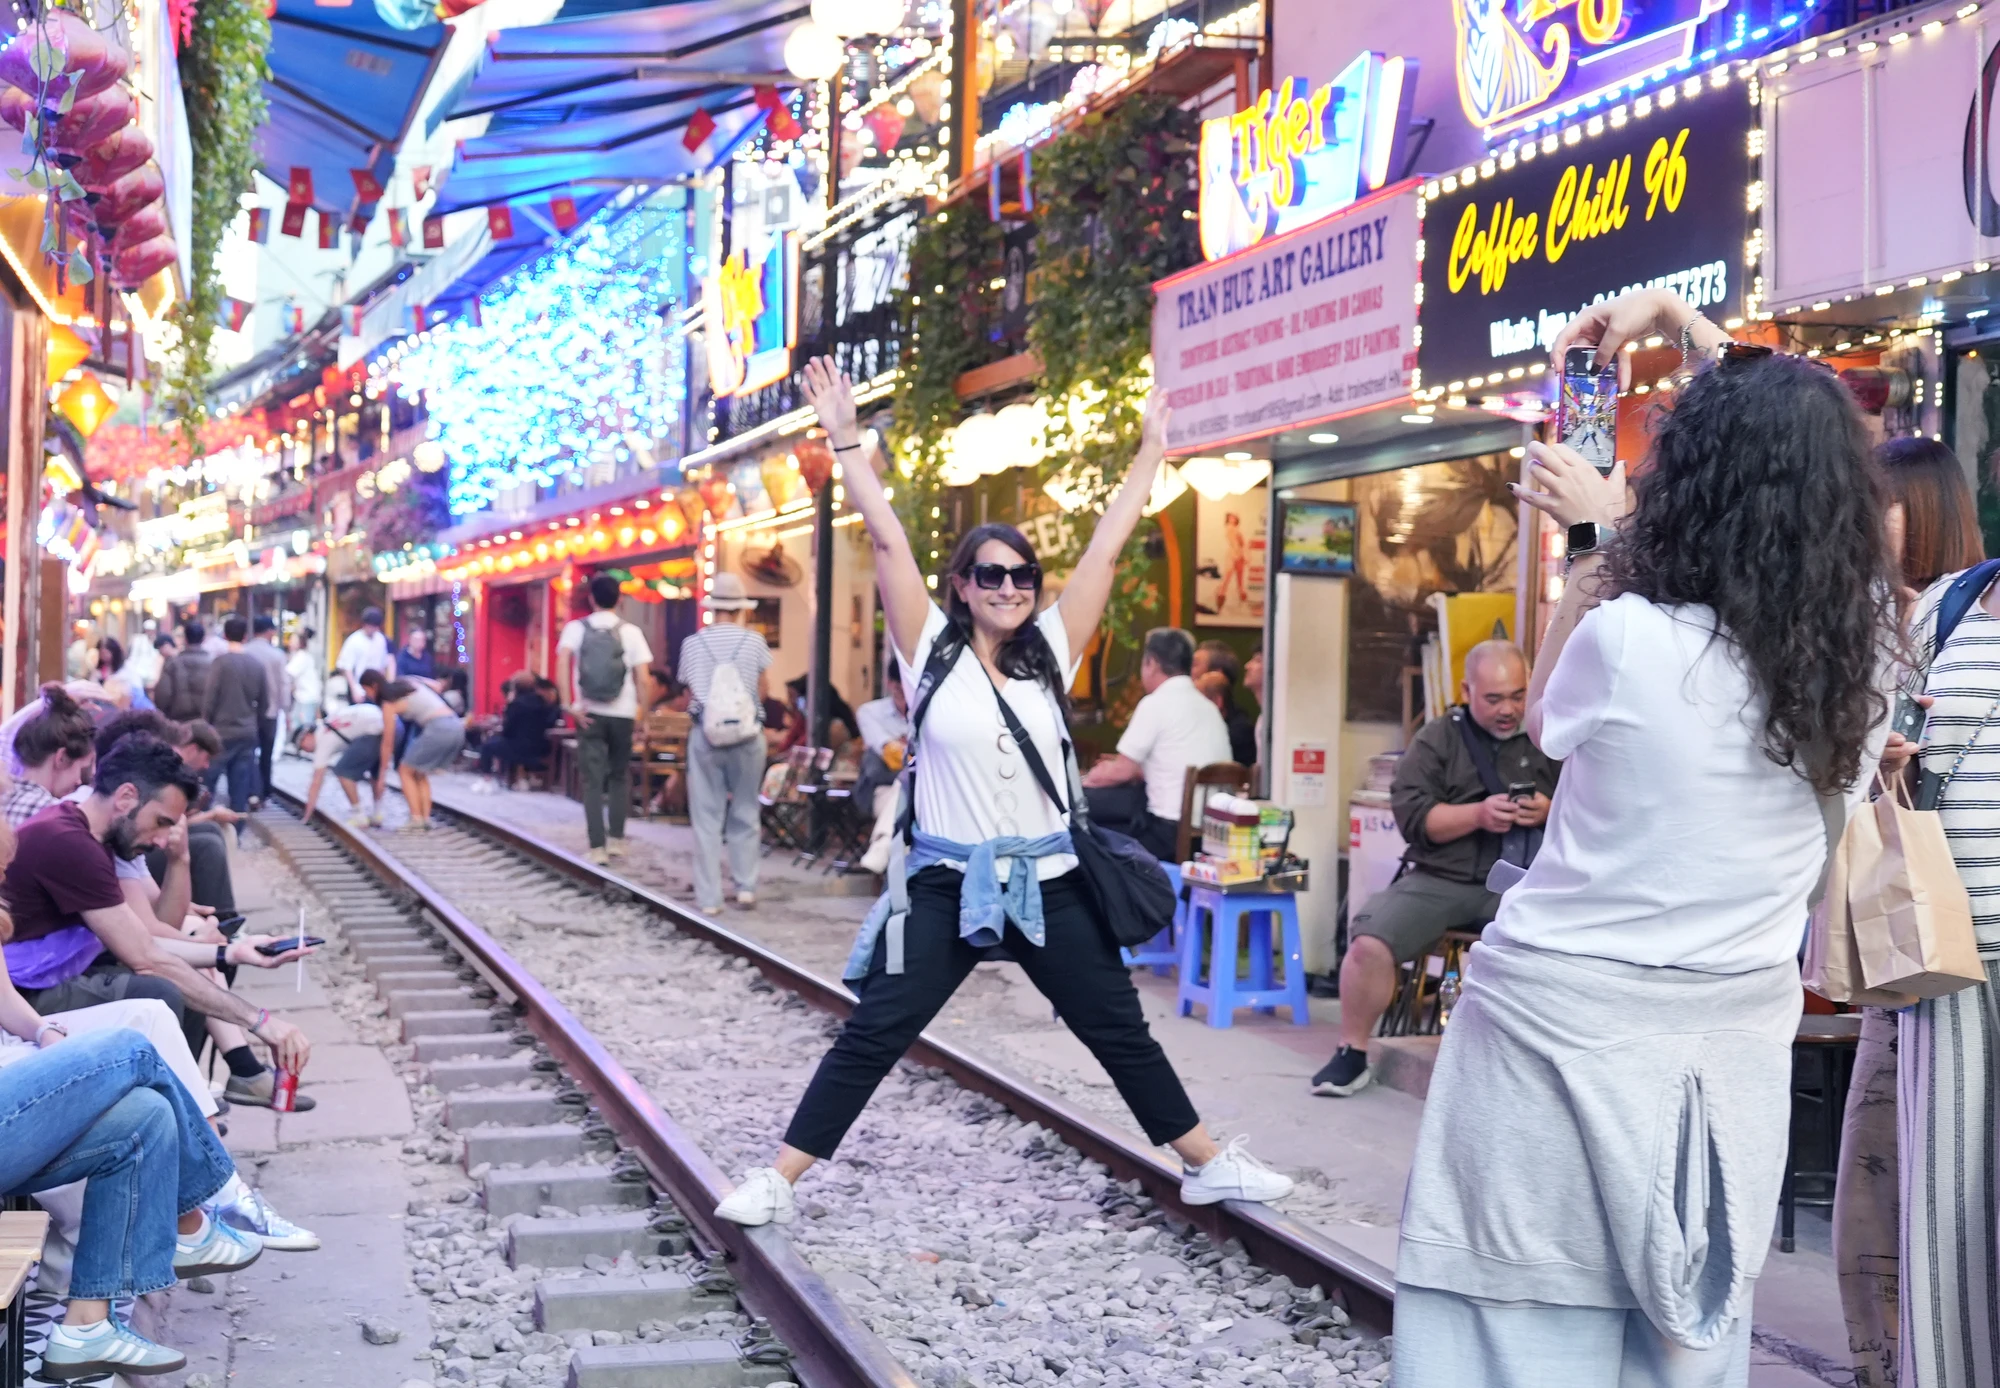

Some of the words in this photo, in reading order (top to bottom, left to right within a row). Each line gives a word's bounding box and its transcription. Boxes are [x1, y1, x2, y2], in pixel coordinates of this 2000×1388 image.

[1231, 75, 1332, 208] Tiger
[1178, 281, 1218, 330] TRAN
[1222, 266, 1255, 315] HUE
[1260, 251, 1295, 301] ART
[1300, 214, 1388, 287] GALLERY
[1448, 197, 1539, 296] Coffee
[1545, 153, 1632, 264] Chill
[1643, 127, 1690, 222] 96
